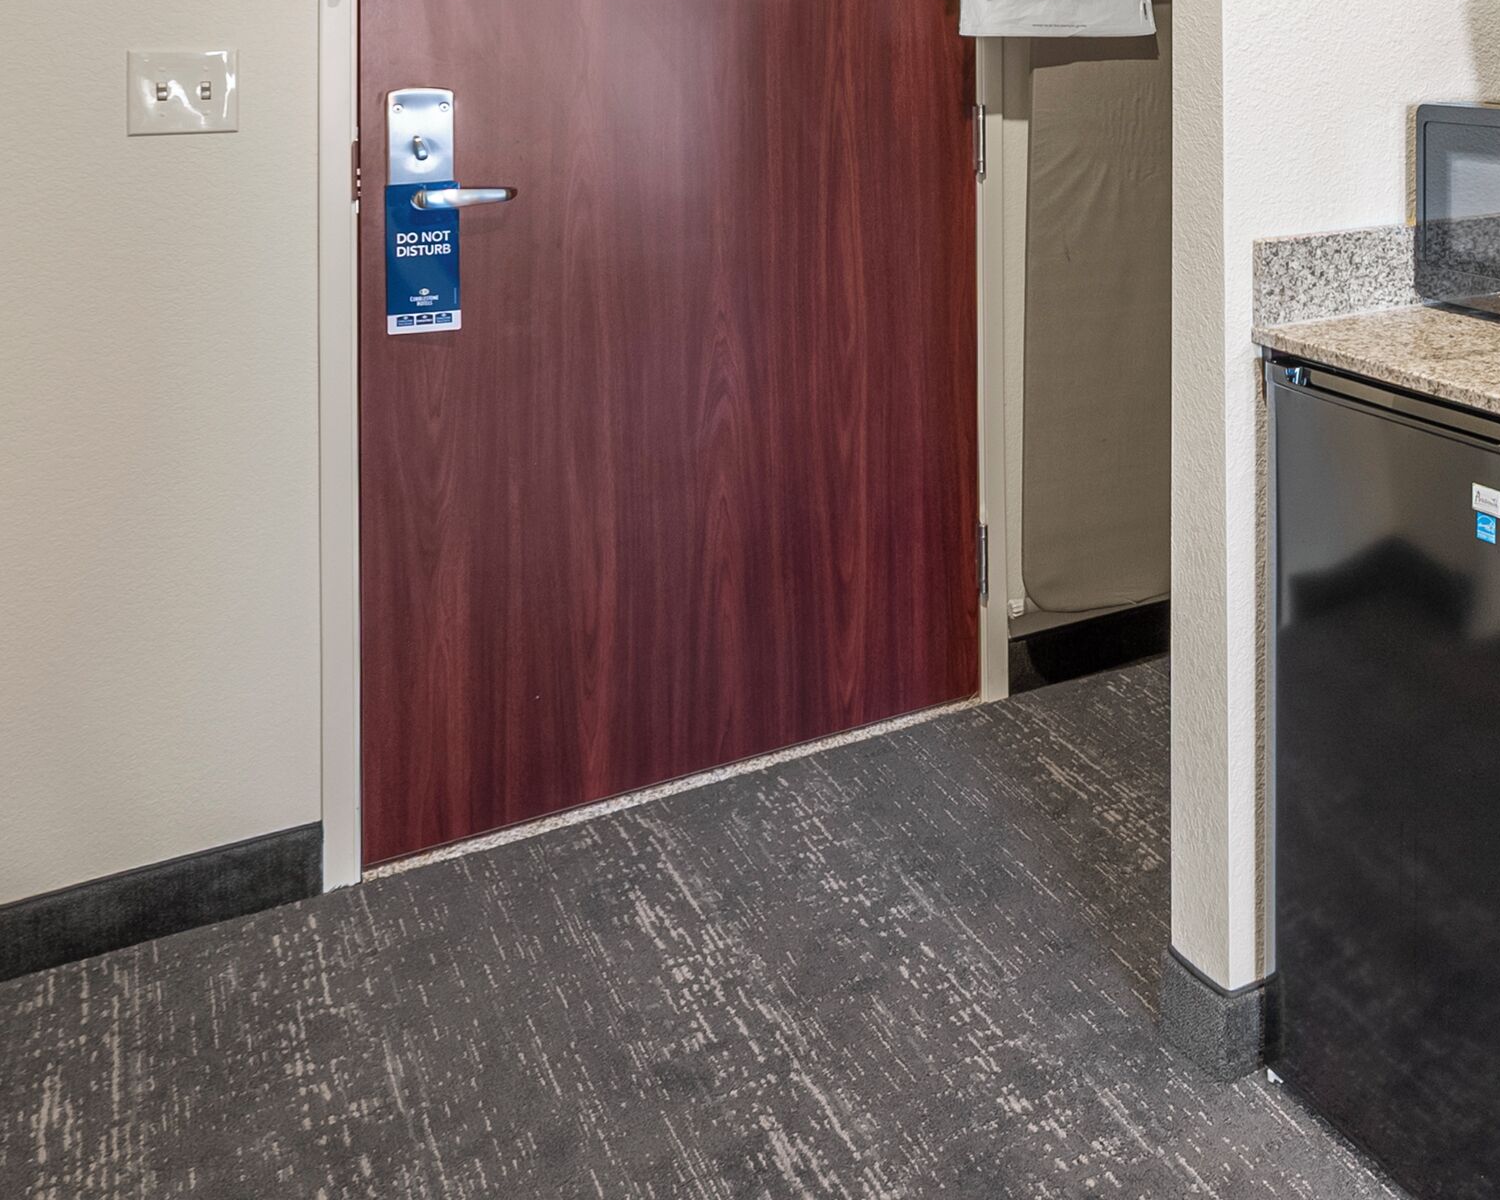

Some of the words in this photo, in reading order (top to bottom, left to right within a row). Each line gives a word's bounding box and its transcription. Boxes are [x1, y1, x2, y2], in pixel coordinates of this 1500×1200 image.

[396, 232, 418, 244] DO
[421, 230, 451, 243] NOT
[396, 243, 451, 258] DISTURB
